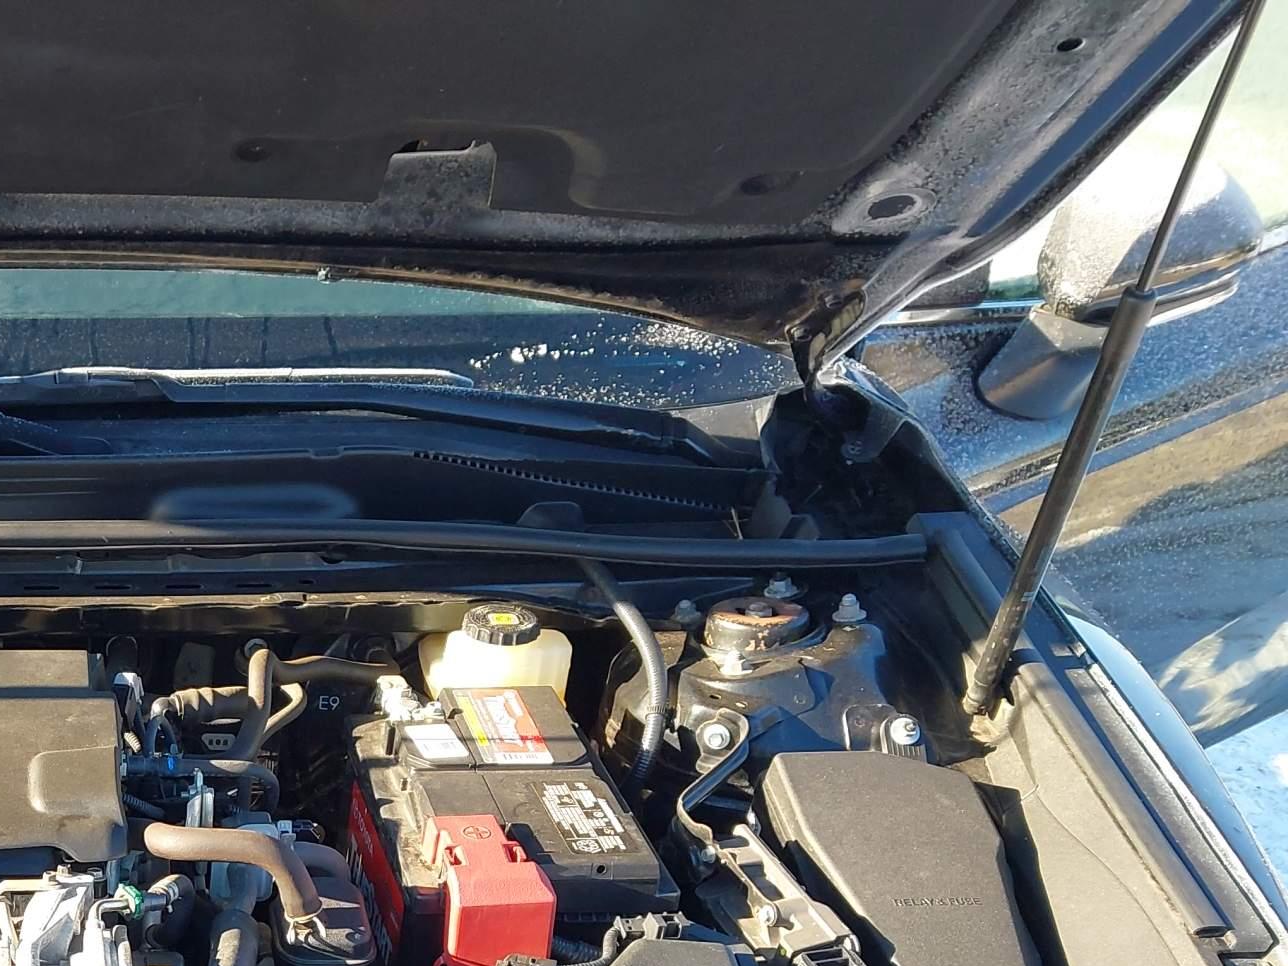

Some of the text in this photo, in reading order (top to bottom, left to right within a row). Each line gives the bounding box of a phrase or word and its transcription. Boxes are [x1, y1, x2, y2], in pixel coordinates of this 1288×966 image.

[319, 695, 340, 710] E9
[893, 898, 933, 907] RELAY
[949, 897, 983, 906] FUSE
